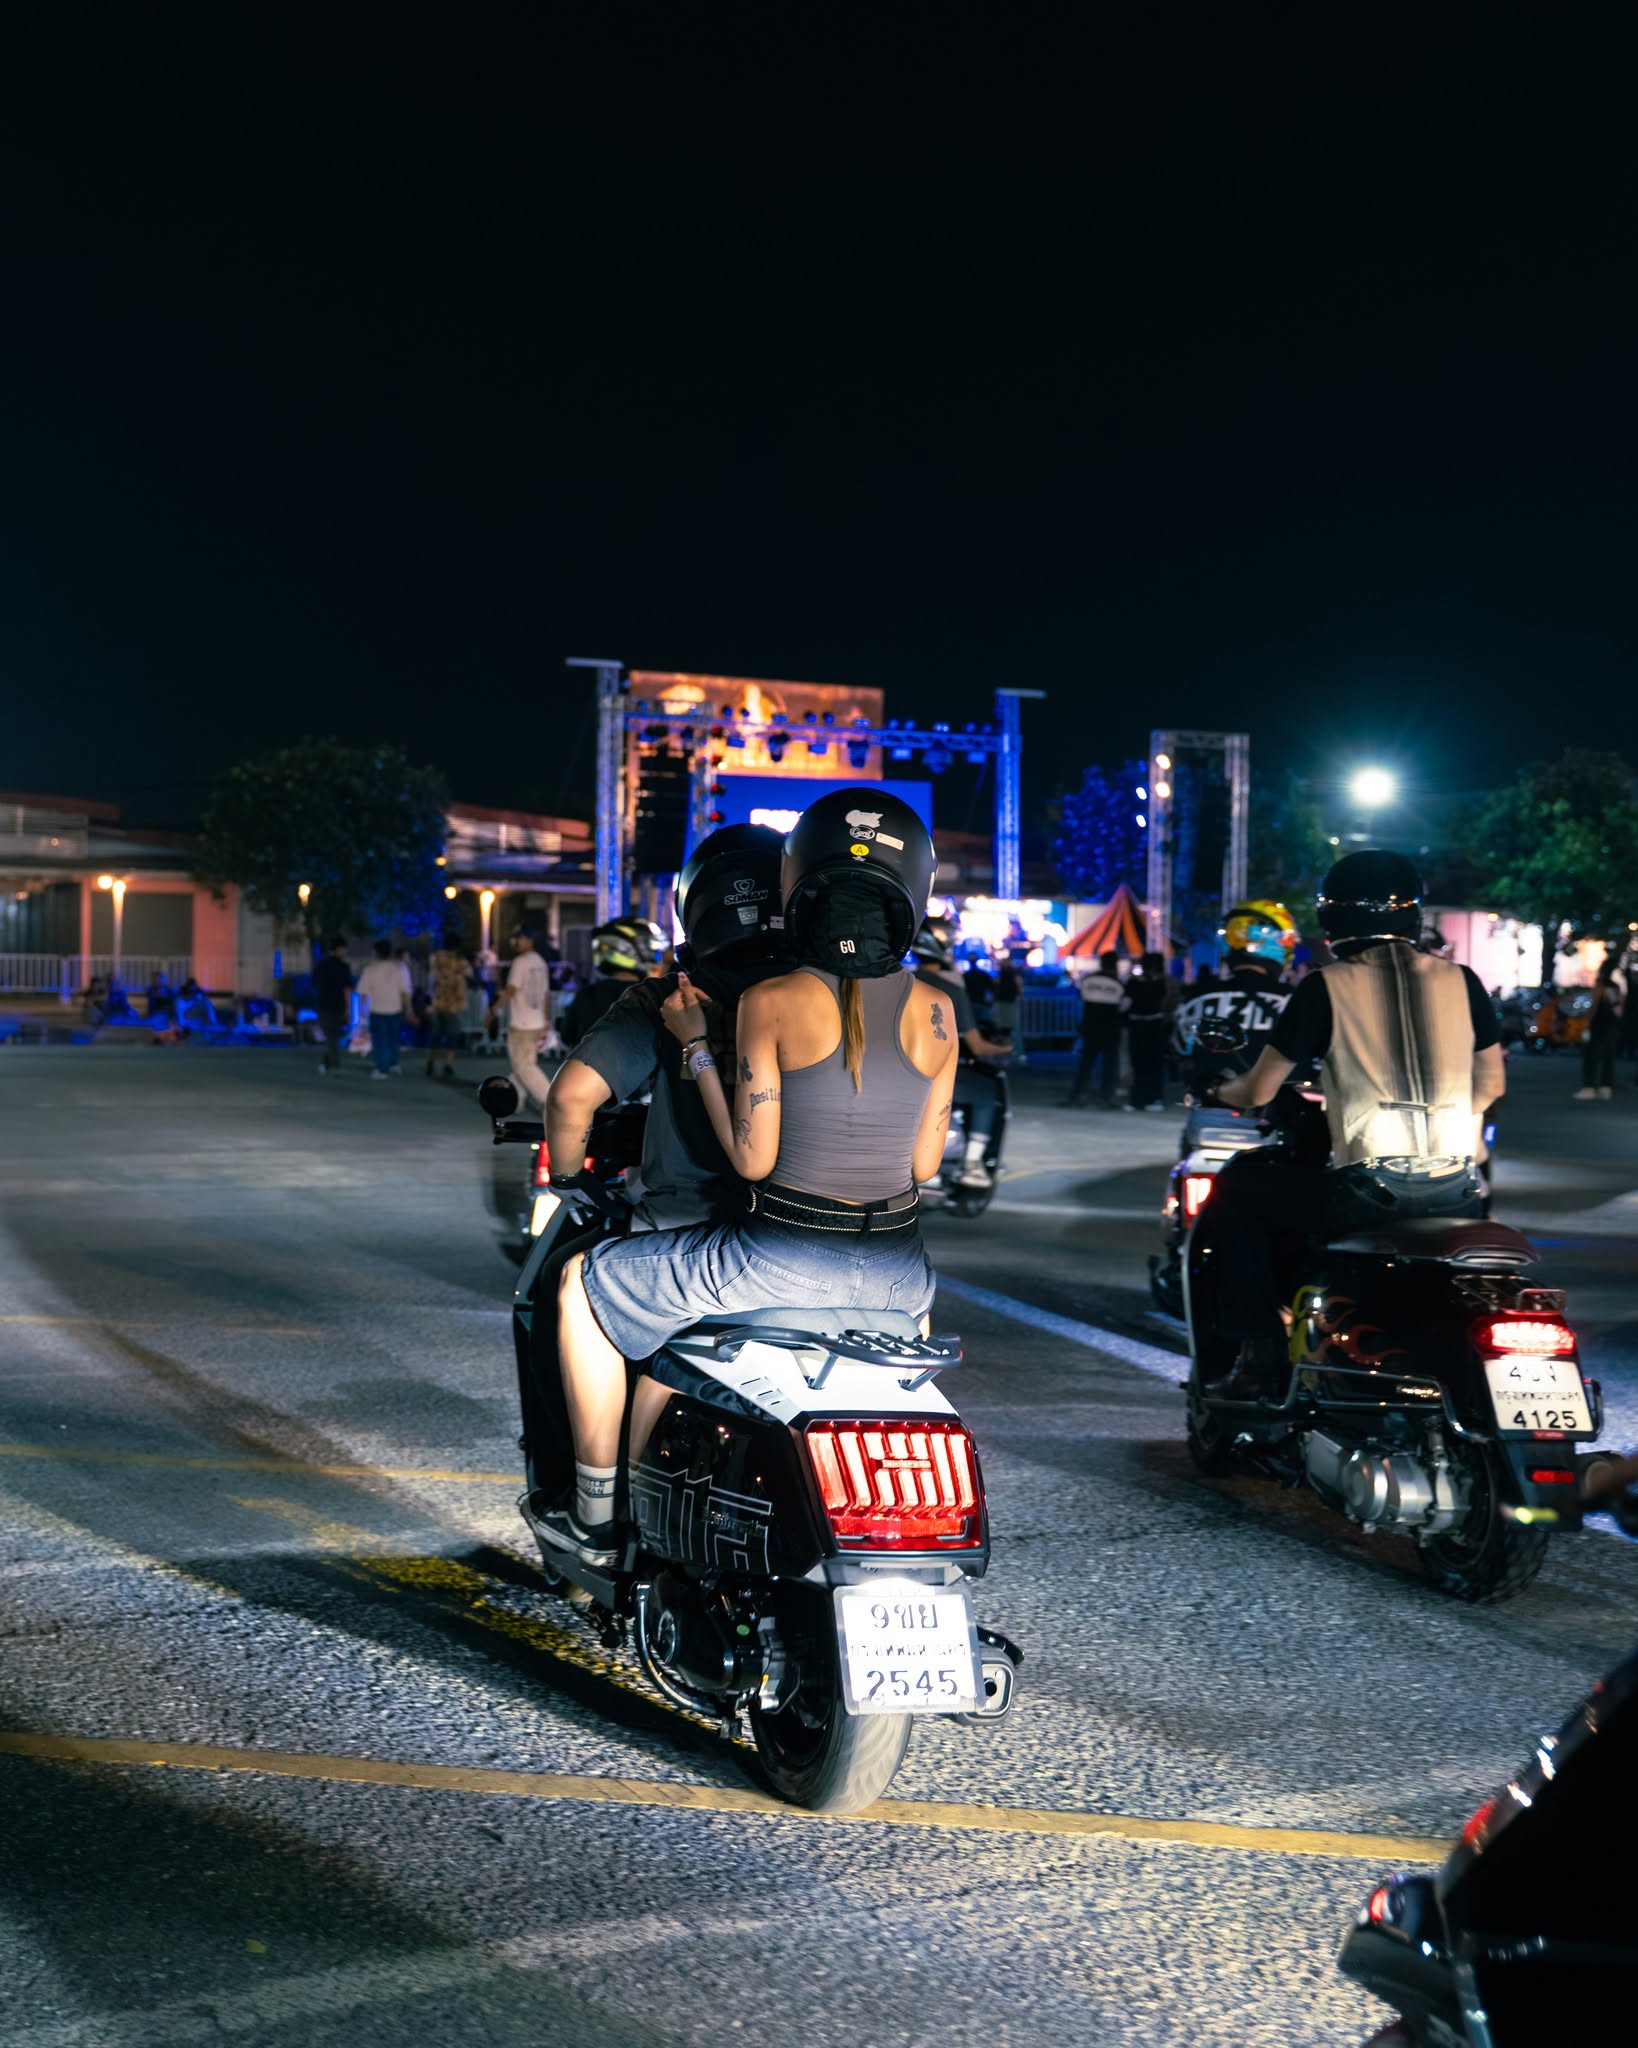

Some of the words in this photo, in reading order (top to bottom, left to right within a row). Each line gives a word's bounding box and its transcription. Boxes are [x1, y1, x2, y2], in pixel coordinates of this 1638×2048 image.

[855, 845, 864, 855] A
[723, 889, 769, 906] SOMAN
[1513, 1410, 1578, 1430] 4125
[866, 1669, 958, 1705] 2545
